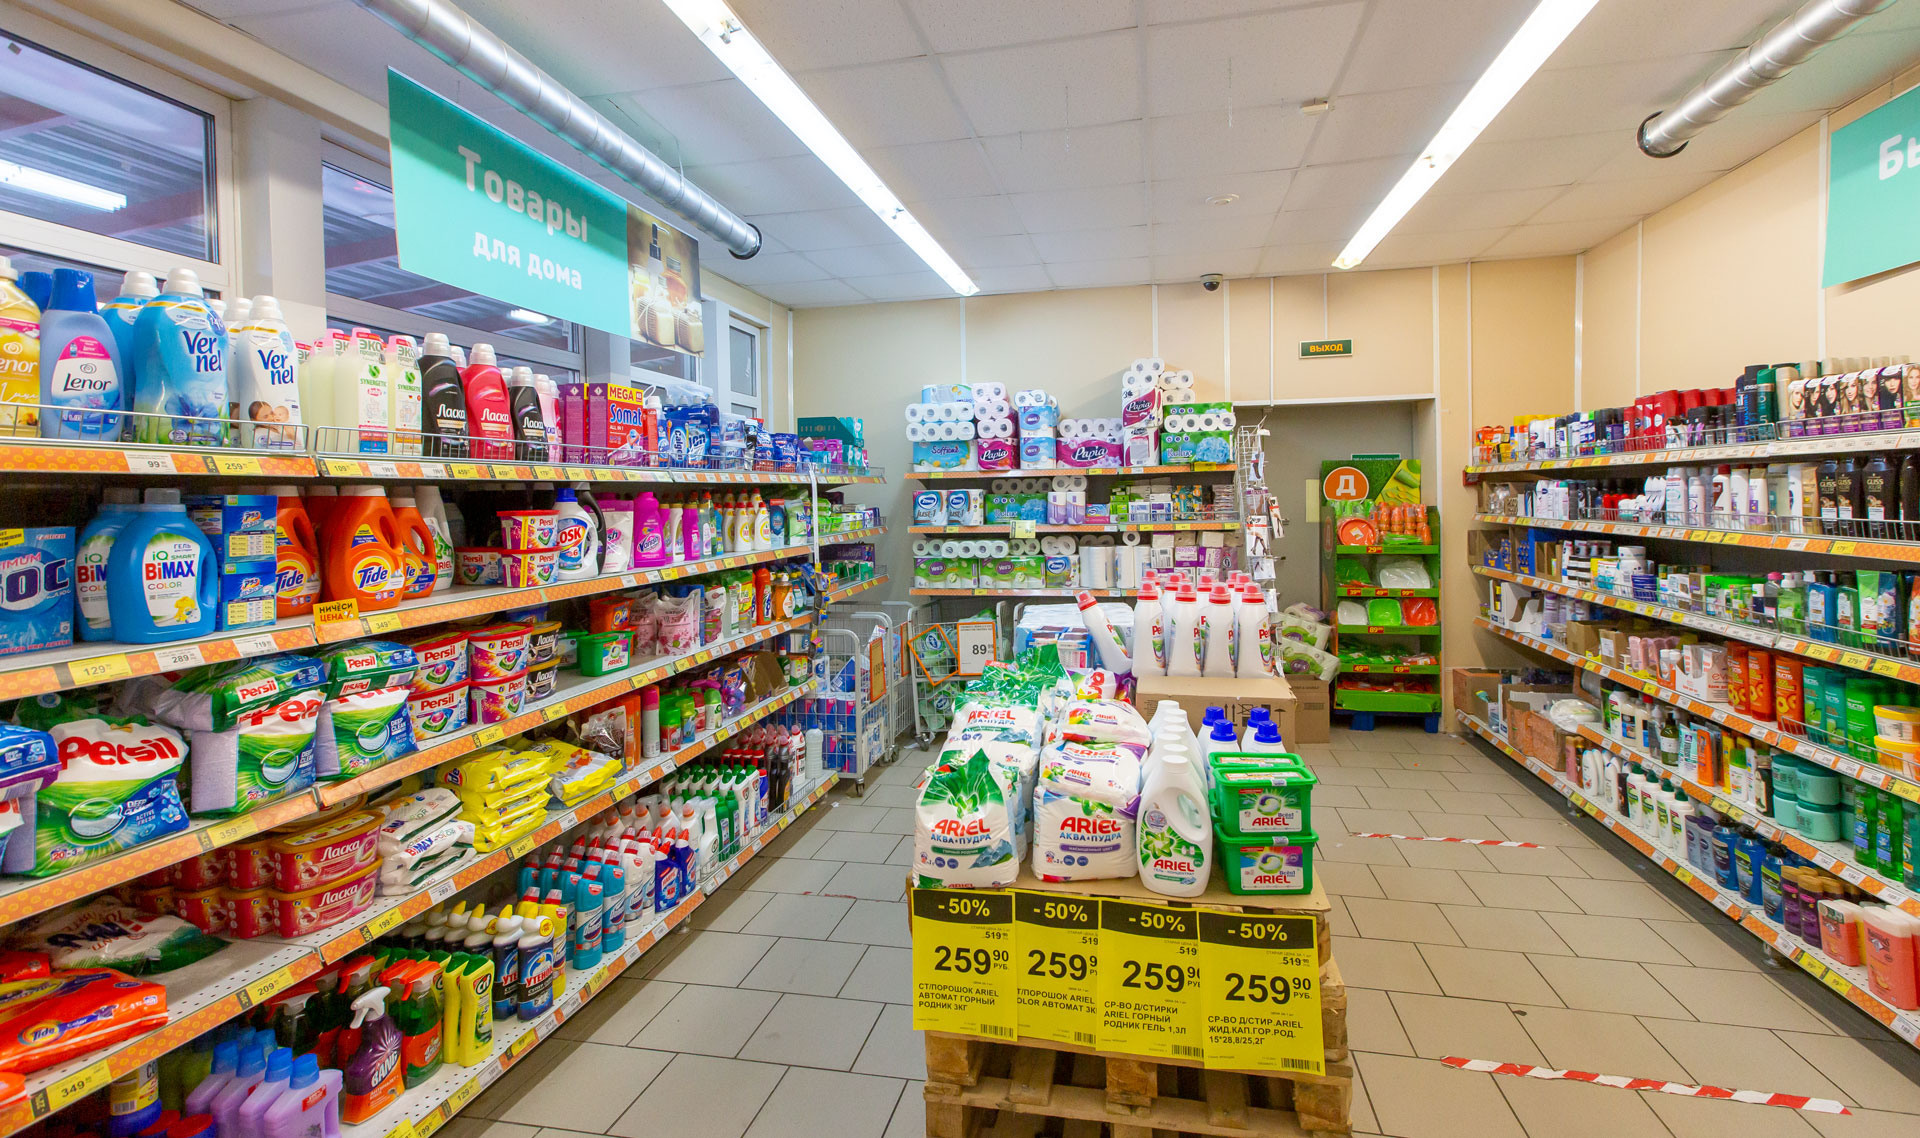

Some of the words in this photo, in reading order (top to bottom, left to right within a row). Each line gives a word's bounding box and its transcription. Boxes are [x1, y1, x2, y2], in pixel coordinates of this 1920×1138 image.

[458, 145, 588, 243] Товары
[473, 231, 521, 269] для
[527, 253, 583, 291] дома
[182, 331, 217, 355] Ver
[1310, 344, 1343, 352] ВЫХОД
[196, 350, 222, 372] nel
[258, 349, 288, 370] Ver
[270, 366, 294, 385] nel
[63, 373, 112, 392] Lenor
[610, 386, 634, 401] MEGA
[437, 403, 466, 420] Ласка
[1127, 400, 1152, 412] Papia
[481, 408, 509, 423] Ласка
[609, 404, 643, 427] Somat
[523, 417, 543, 429] Ласка
[1074, 446, 1106, 459] Papia
[148, 460, 160, 468] 99
[225, 462, 243, 471] 259
[1336, 475, 1356, 496] Д
[539, 518, 554, 526] Persil
[558, 527, 582, 544] OSK
[0, 552, 42, 570] IMUM
[152, 551, 168, 560] iQ
[463, 552, 483, 563] Persil
[145, 560, 195, 580] BiMAX
[438, 561, 452, 570] RIEL
[358, 564, 389, 590] Tide
[148, 582, 182, 590] COLOR
[320, 613, 343, 622] ЦЕНА
[500, 634, 524, 649] Persil
[424, 645, 455, 662] Persil
[973, 644, 986, 655] 89
[172, 655, 189, 663] 289
[348, 656, 375, 668] Persil
[84, 665, 106, 676] 129
[421, 693, 454, 711] Persil
[58, 736, 179, 771] Persil
[931, 818, 990, 837] ARIEL
[1060, 817, 1121, 835] ARIEL
[1252, 818, 1289, 826] ARIEL
[219, 828, 237, 839] 359
[931, 833, 955, 844] АКВА
[959, 834, 991, 844] ПУДРА
[1060, 833, 1085, 842] АКВА
[1091, 833, 1122, 842] ПУДРА
[320, 840, 361, 862] Ласка
[1154, 860, 1194, 872] ARIEL
[1253, 875, 1291, 884] ARIEL
[319, 883, 358, 907] Ласка
[378, 919, 391, 929] 199
[985, 931, 1001, 939] 519
[1082, 937, 1098, 945] 519
[1179, 946, 1197, 956] 519
[934, 945, 991, 975] 259
[993, 950, 1009, 962] 90
[1028, 949, 1087, 981] 259
[1282, 957, 1301, 966] 519
[1122, 960, 1185, 993] 259
[257, 984, 275, 996] 209
[918, 983, 973, 994] СТ/ПОРОШОК
[975, 989, 999, 997] ARIEL
[1224, 972, 1291, 1005] 259
[1292, 977, 1311, 990] 90
[918, 992, 957, 1001] АВТОМАТ
[960, 994, 995, 1005] ГОРНЫЙ
[1070, 995, 1094, 1004] ARIEL
[1293, 991, 1313, 1000] РУБ.
[918, 1001, 952, 1010] РОДНИК
[1042, 1001, 1083, 1012] АВТОМАТ
[1086, 1006, 1097, 1014] 3К
[1104, 1001, 1132, 1010] СР-ВО
[1134, 1003, 1178, 1014] Д/СТИРКИ
[1104, 1011, 1129, 1019] ARIEL
[1132, 1012, 1171, 1023] ГОРНЫЙ
[1207, 1016, 1237, 1024] СР-ВО
[1239, 1016, 1304, 1028] Д/СТИР.ARIEL
[1103, 1020, 1140, 1030] РОДНИК
[1142, 1023, 1166, 1032] ГЕЛЬ
[1168, 1026, 1187, 1035] 1,3Л
[1208, 1025, 1297, 1038] ЖИД.КАП.ГОР.РОД.
[32, 1028, 55, 1042] Tide
[371, 1050, 398, 1088] BANG
[61, 1081, 85, 1098] 349
